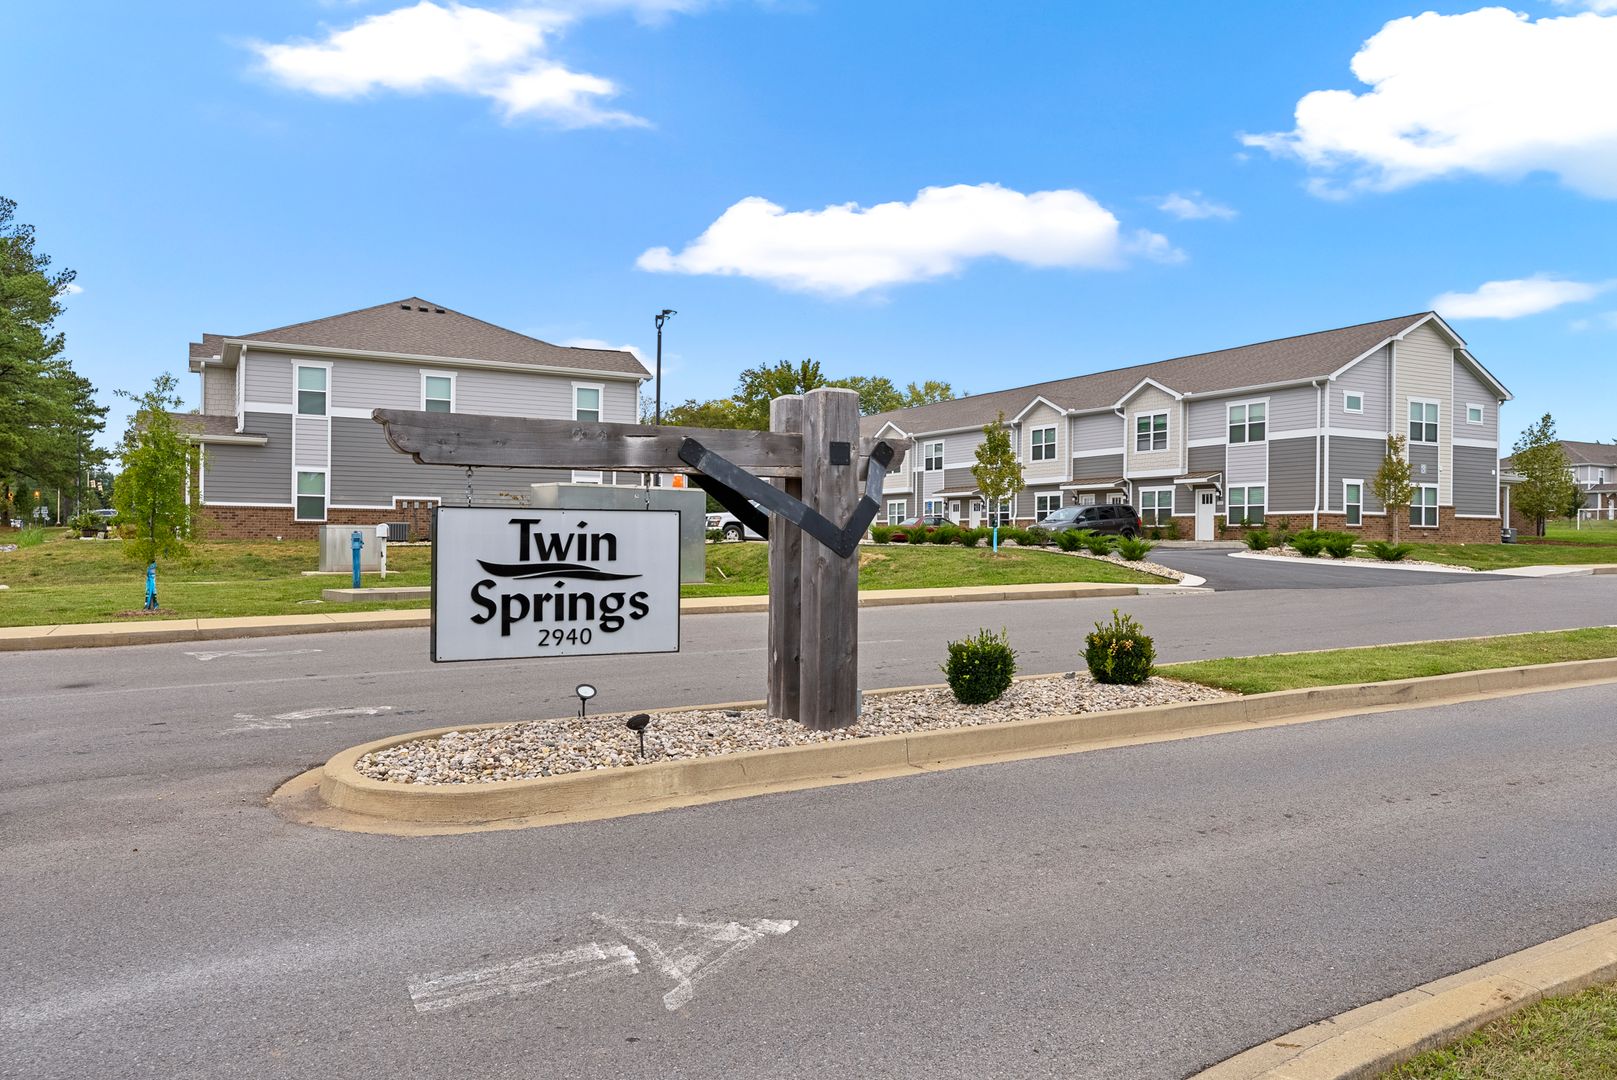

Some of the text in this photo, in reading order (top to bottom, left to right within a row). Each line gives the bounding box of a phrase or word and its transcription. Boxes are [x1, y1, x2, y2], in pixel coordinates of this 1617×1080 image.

[508, 518, 617, 562] Twin
[470, 579, 649, 637] Springs
[538, 628, 592, 647] 2940
